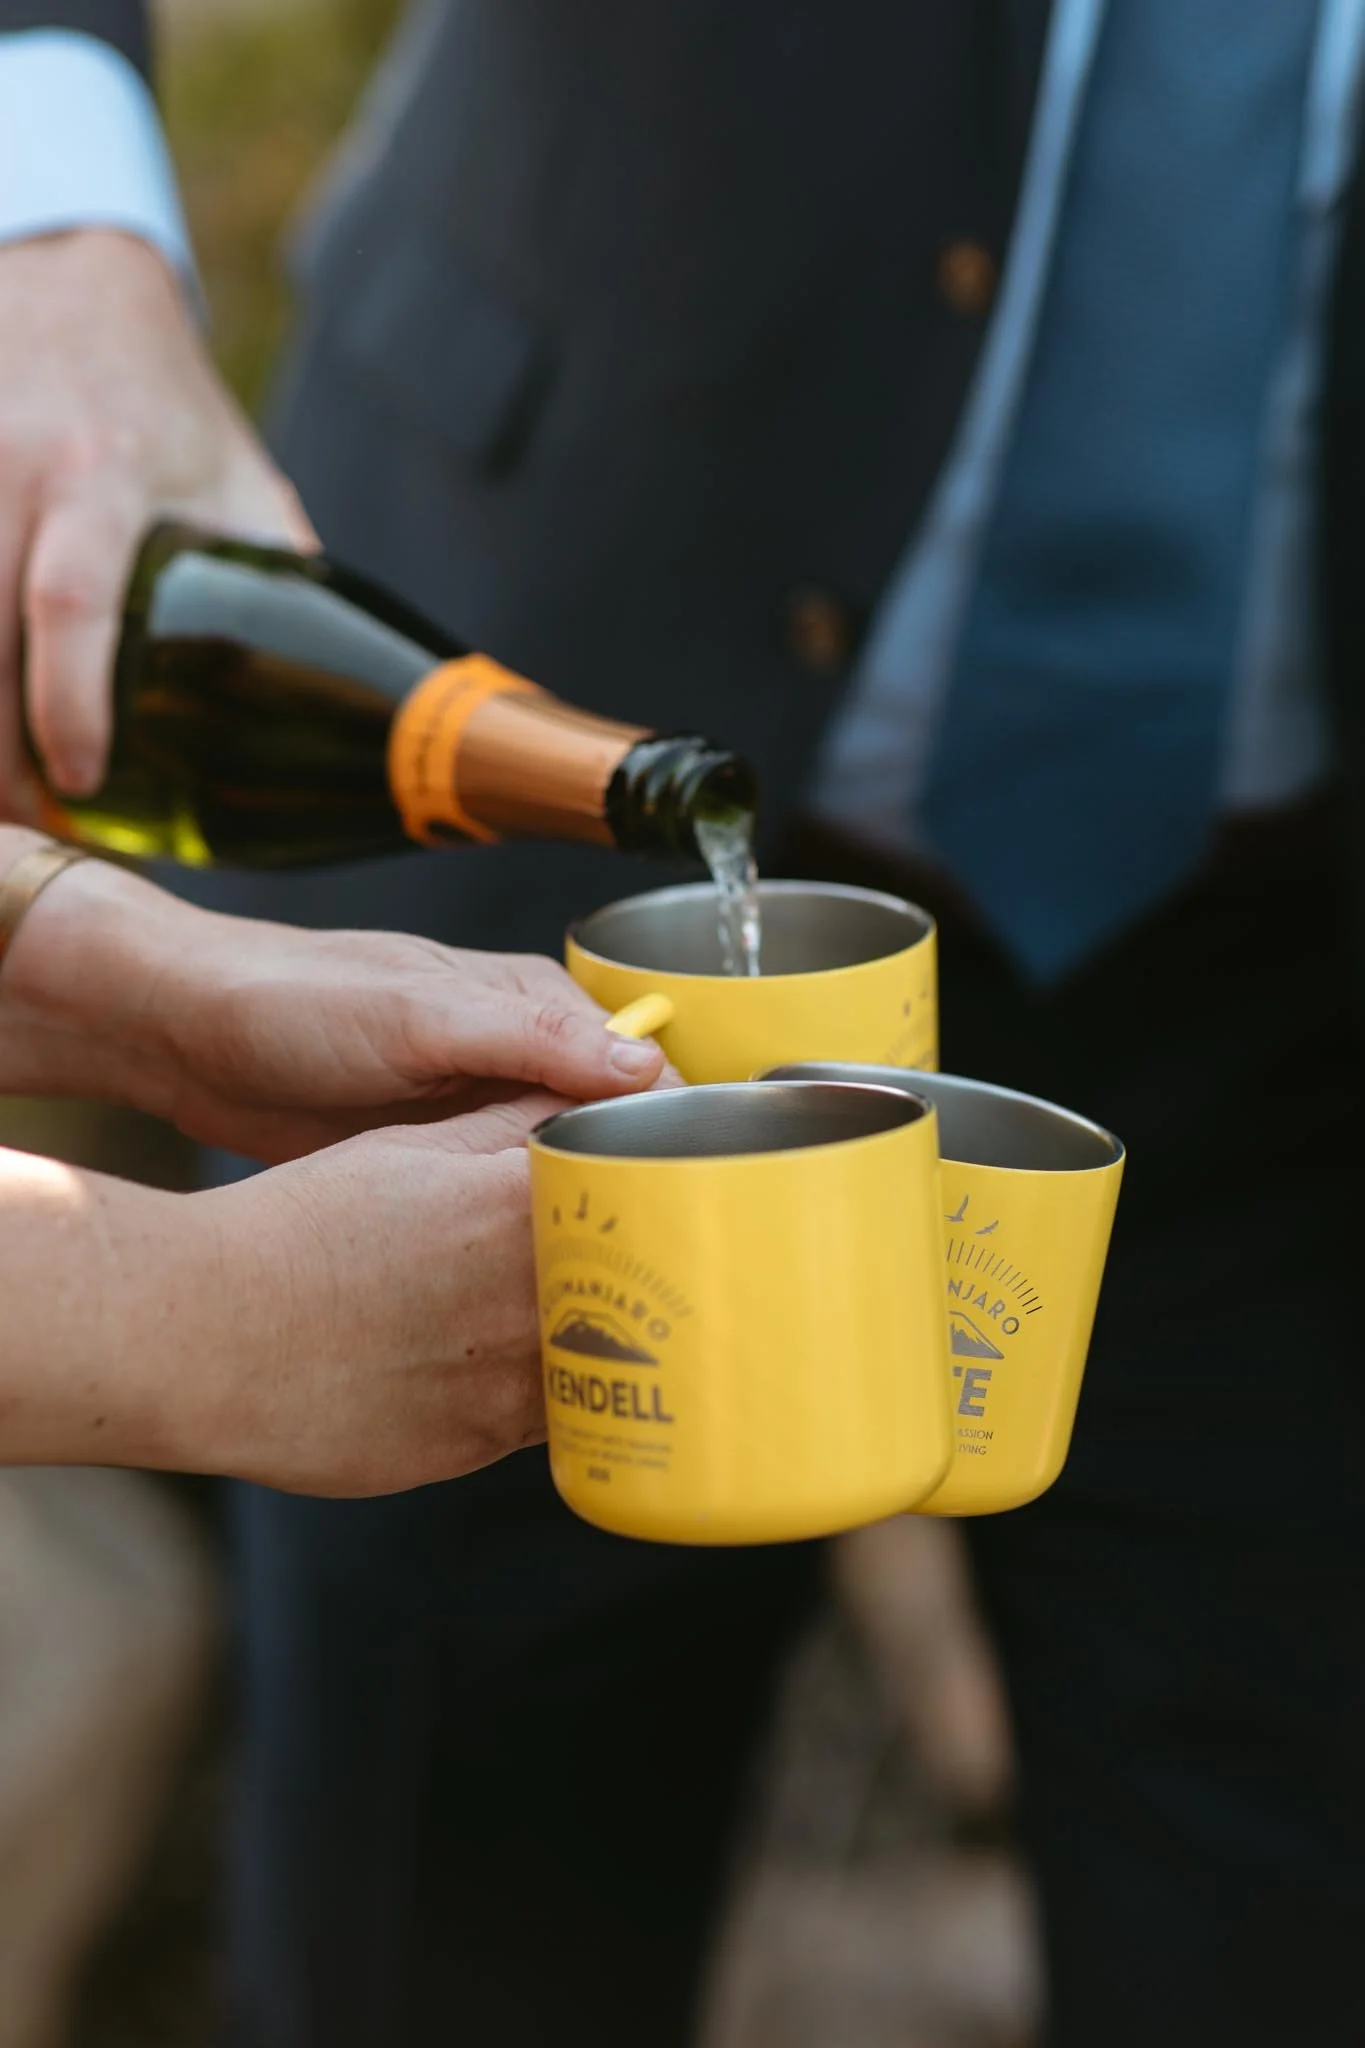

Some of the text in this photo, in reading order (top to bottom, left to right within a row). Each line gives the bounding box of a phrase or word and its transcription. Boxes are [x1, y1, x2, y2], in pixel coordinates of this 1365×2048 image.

[947, 1277, 1020, 1335] NJARO
[953, 1366, 993, 1417] E
[957, 1427, 994, 1441] ASSION
[957, 1442, 988, 1456] IVING
